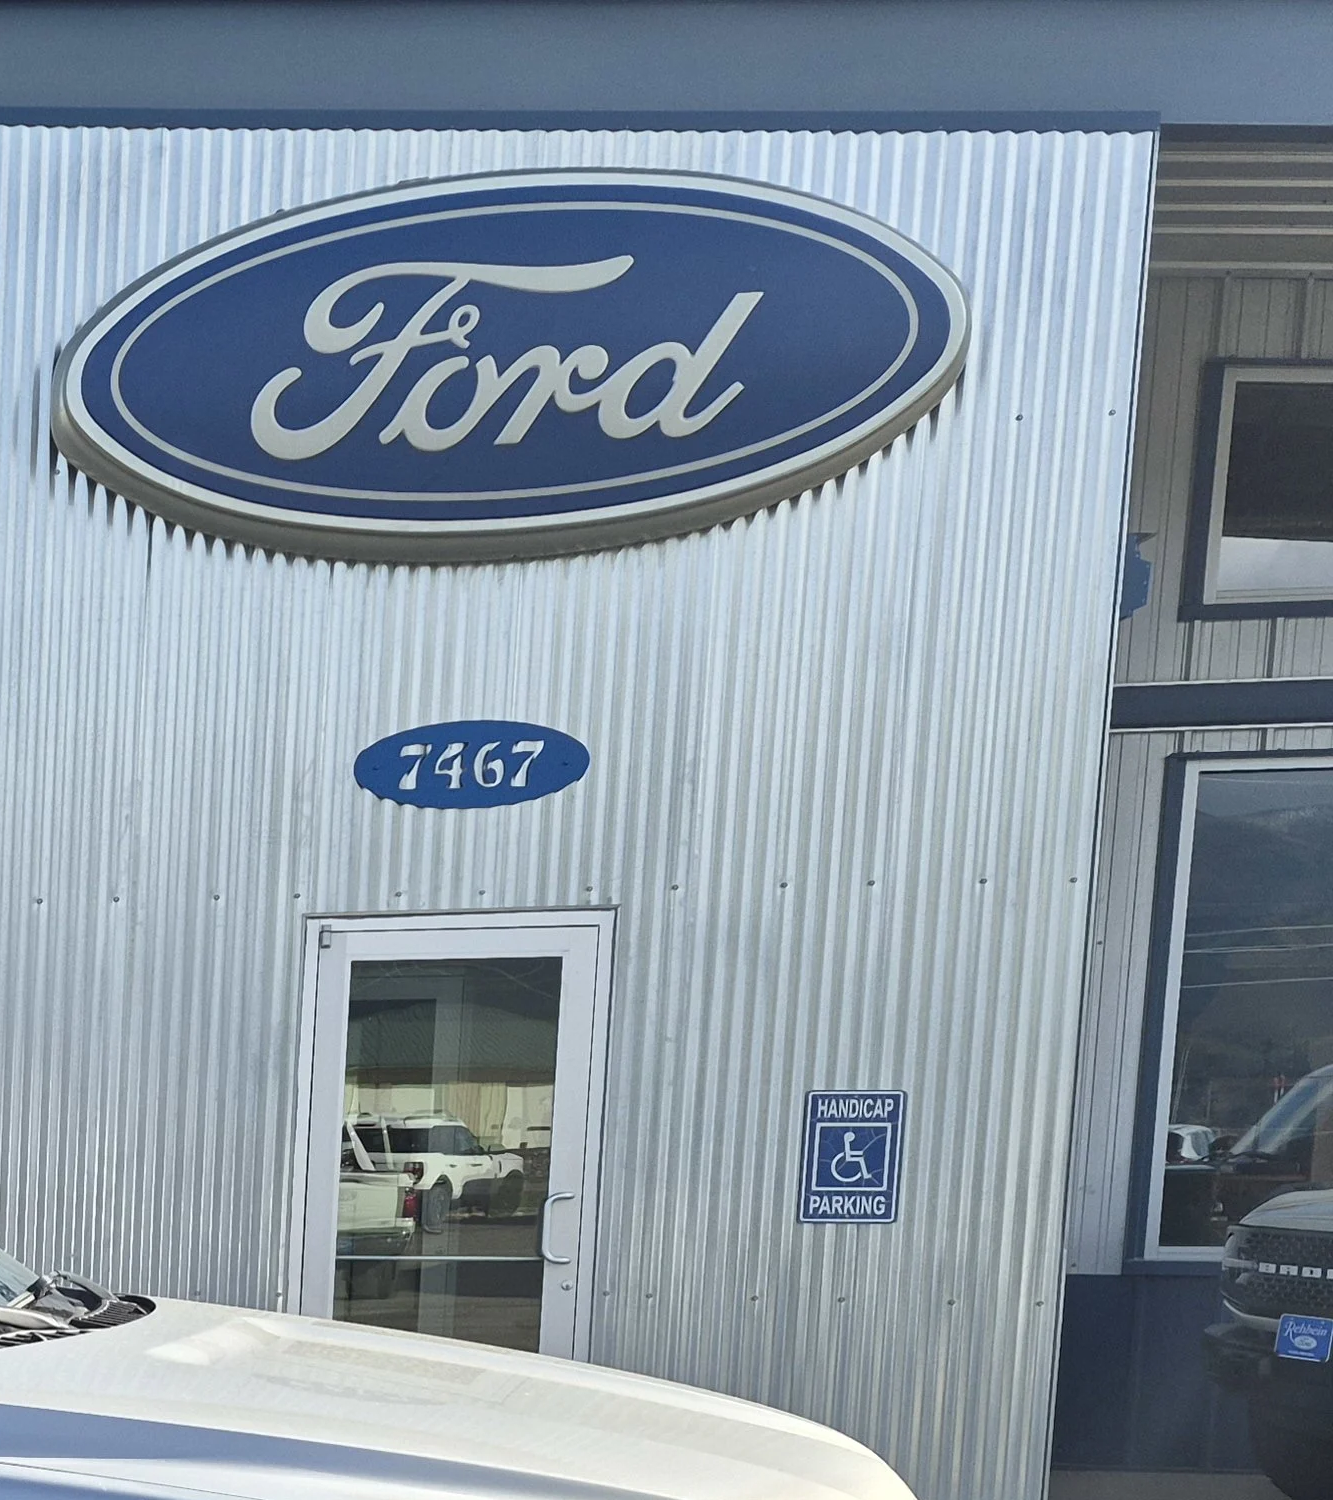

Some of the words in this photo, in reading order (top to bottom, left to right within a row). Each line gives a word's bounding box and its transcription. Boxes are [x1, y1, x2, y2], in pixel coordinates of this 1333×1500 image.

[250, 254, 764, 461] Ford
[397, 740, 545, 790] 7467
[817, 1098, 895, 1119] HANDICAP
[809, 1195, 886, 1215] PARKING
[1283, 1321, 1328, 1343] Rehbein
